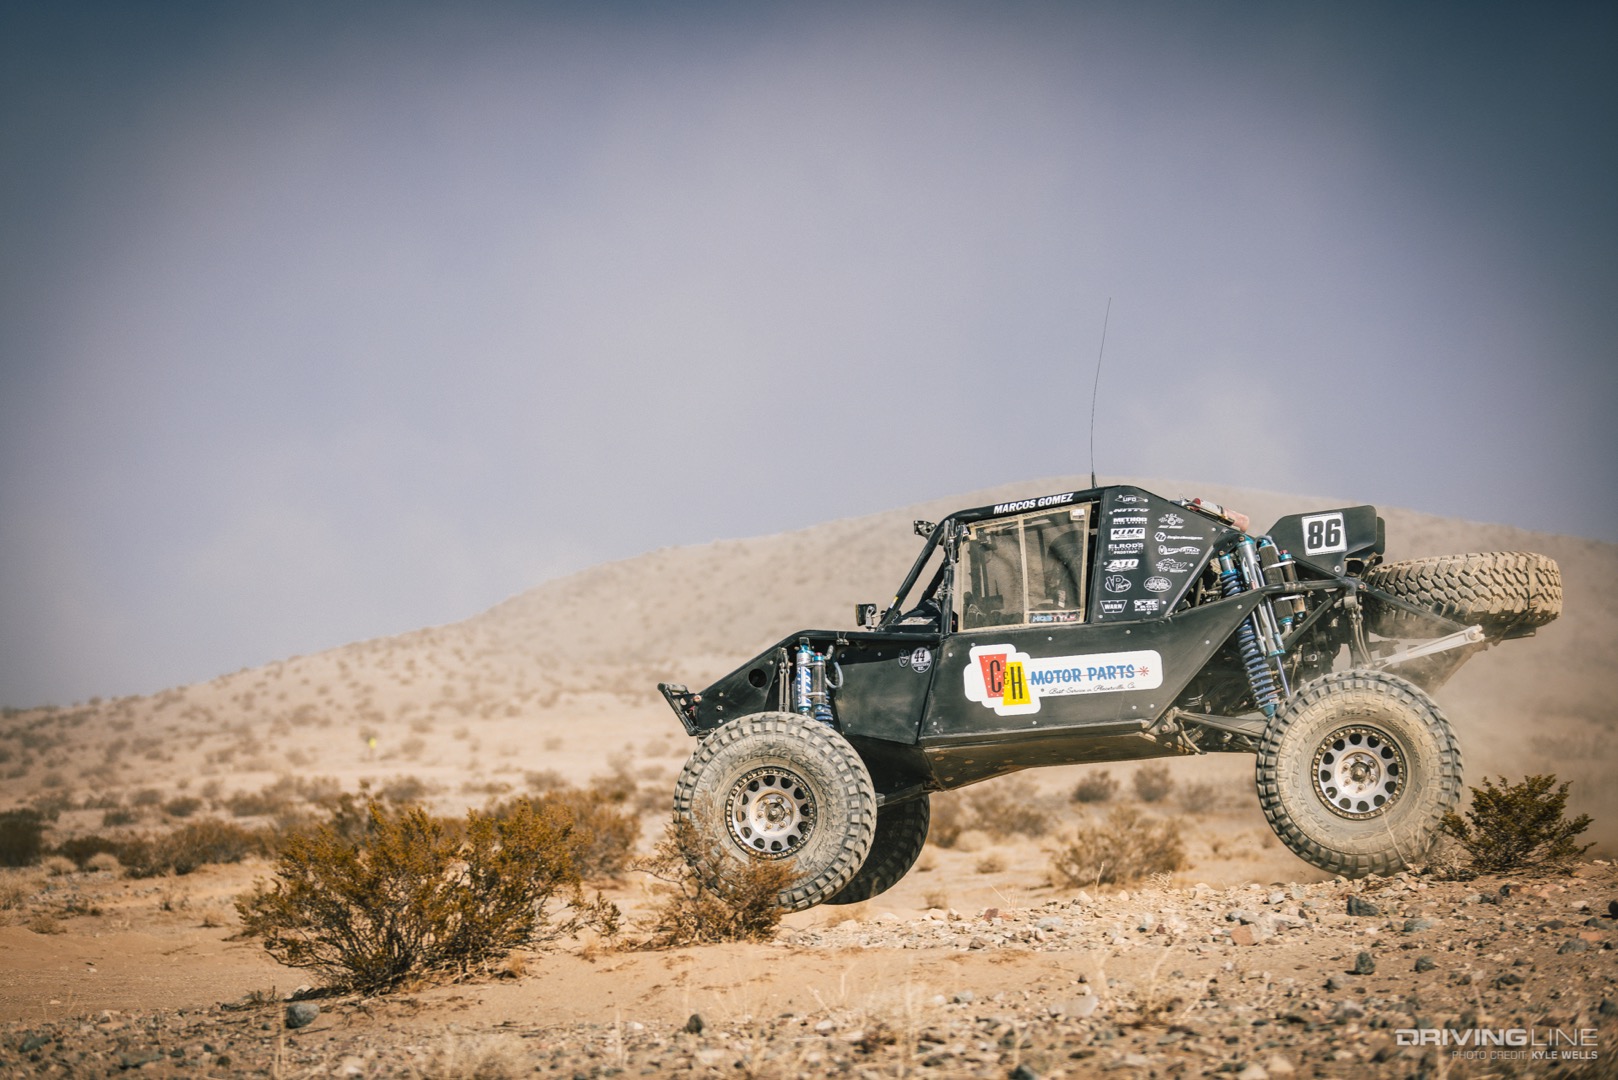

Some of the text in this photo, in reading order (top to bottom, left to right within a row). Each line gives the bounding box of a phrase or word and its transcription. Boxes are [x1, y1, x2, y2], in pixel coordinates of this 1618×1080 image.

[993, 492, 1075, 515] MARCOS GOMEZ
[1112, 528, 1144, 536] KING
[1307, 518, 1342, 550] 86
[914, 649, 926, 662] 44
[1030, 667, 1082, 686] MOTOR
[1086, 663, 1136, 681] PARTS
